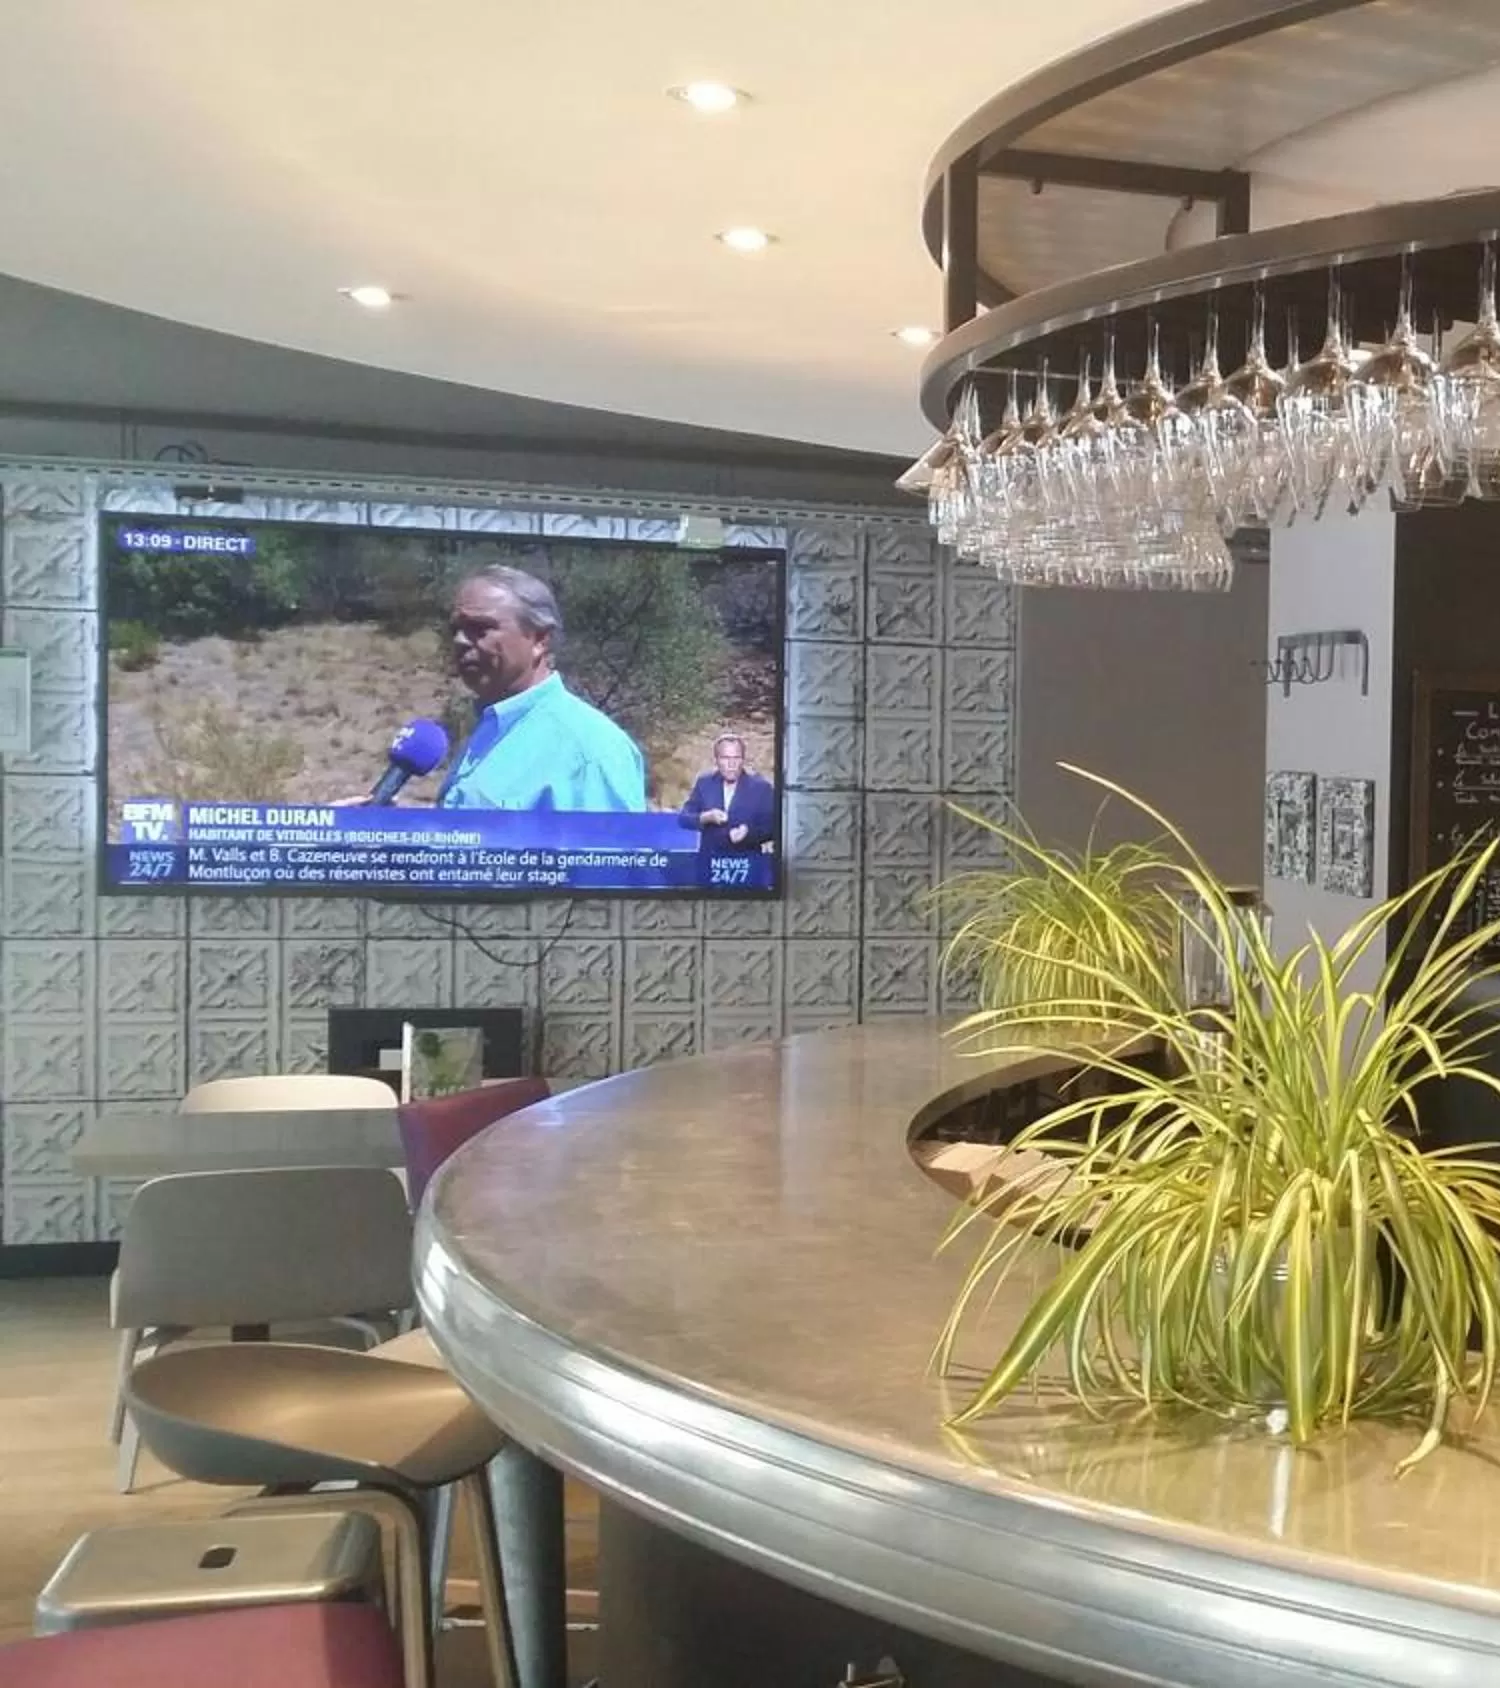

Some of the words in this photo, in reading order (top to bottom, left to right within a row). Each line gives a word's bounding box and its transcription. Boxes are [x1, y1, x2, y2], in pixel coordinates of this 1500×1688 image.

[123, 532, 172, 548] 13:09
[183, 535, 250, 553] DIRECT
[122, 803, 173, 821] BFM
[188, 807, 265, 825] MICHEL
[269, 809, 335, 827] DURAN
[188, 828, 254, 842] HABITANT
[256, 829, 274, 842] DE
[276, 829, 342, 843] VITROLLES
[129, 851, 176, 862] NEWS
[188, 848, 208, 862] M.
[210, 848, 247, 863] Valls
[249, 849, 266, 863] et
[269, 849, 282, 863] B.
[287, 848, 368, 864] Cazeneuve
[370, 852, 387, 864] se
[389, 850, 455, 865] rendront
[457, 851, 467, 866] à
[519, 853, 538, 867] de
[541, 853, 553, 867] la
[557, 854, 647, 871] gendarmerie
[650, 854, 668, 868] de
[711, 857, 750, 869] NEWS
[129, 863, 173, 879] 24/7
[188, 864, 271, 884] Montluçon
[298, 865, 326, 881] des
[328, 864, 405, 882] réservistes
[408, 867, 433, 881] ont
[438, 867, 494, 882] entamé
[495, 867, 524, 882] leur
[711, 869, 749, 883] 24/7
